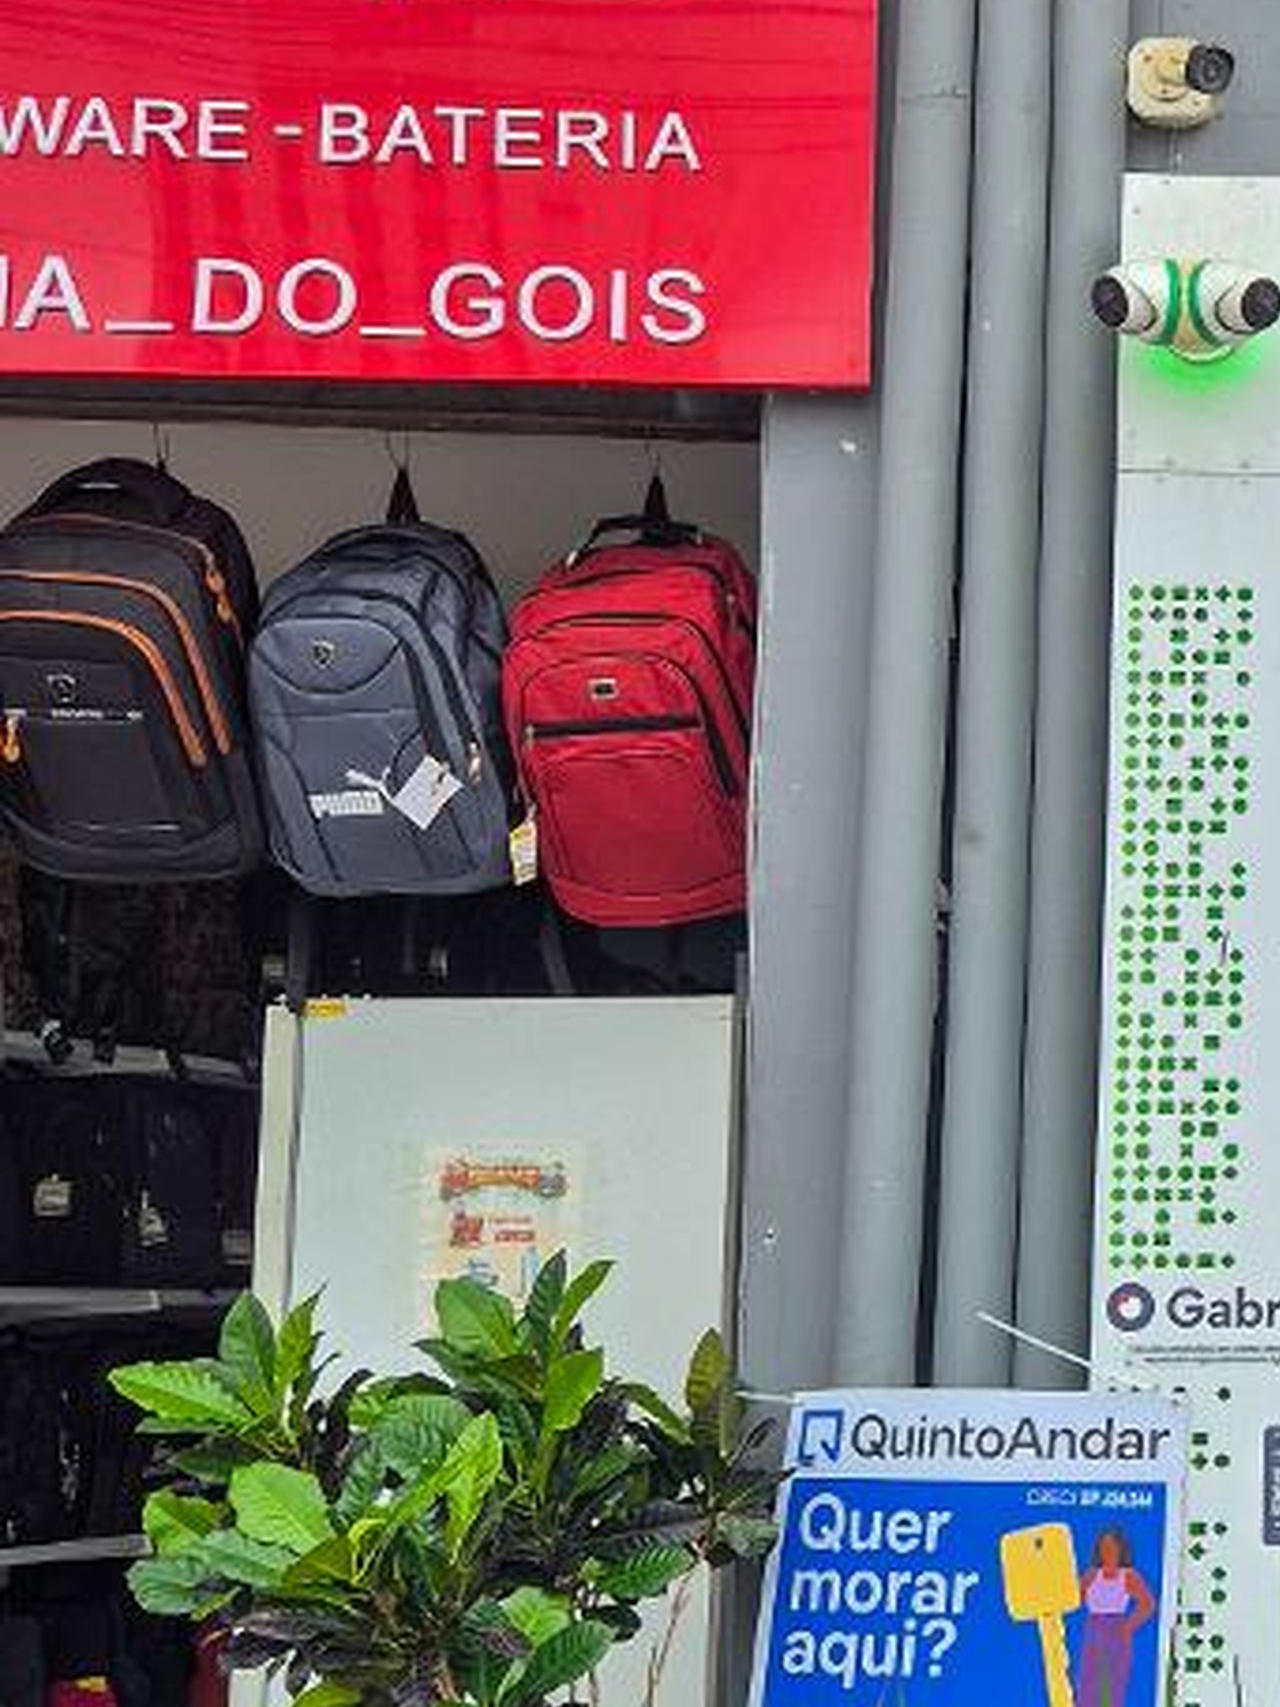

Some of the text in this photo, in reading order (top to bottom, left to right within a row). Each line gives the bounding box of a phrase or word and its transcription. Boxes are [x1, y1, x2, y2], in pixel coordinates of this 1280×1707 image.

[850, 1414, 1171, 1462] QuintoAndar
[799, 1493, 951, 1554] Quer
[788, 1570, 979, 1615] morar
[781, 1620, 958, 1689] aqui?
